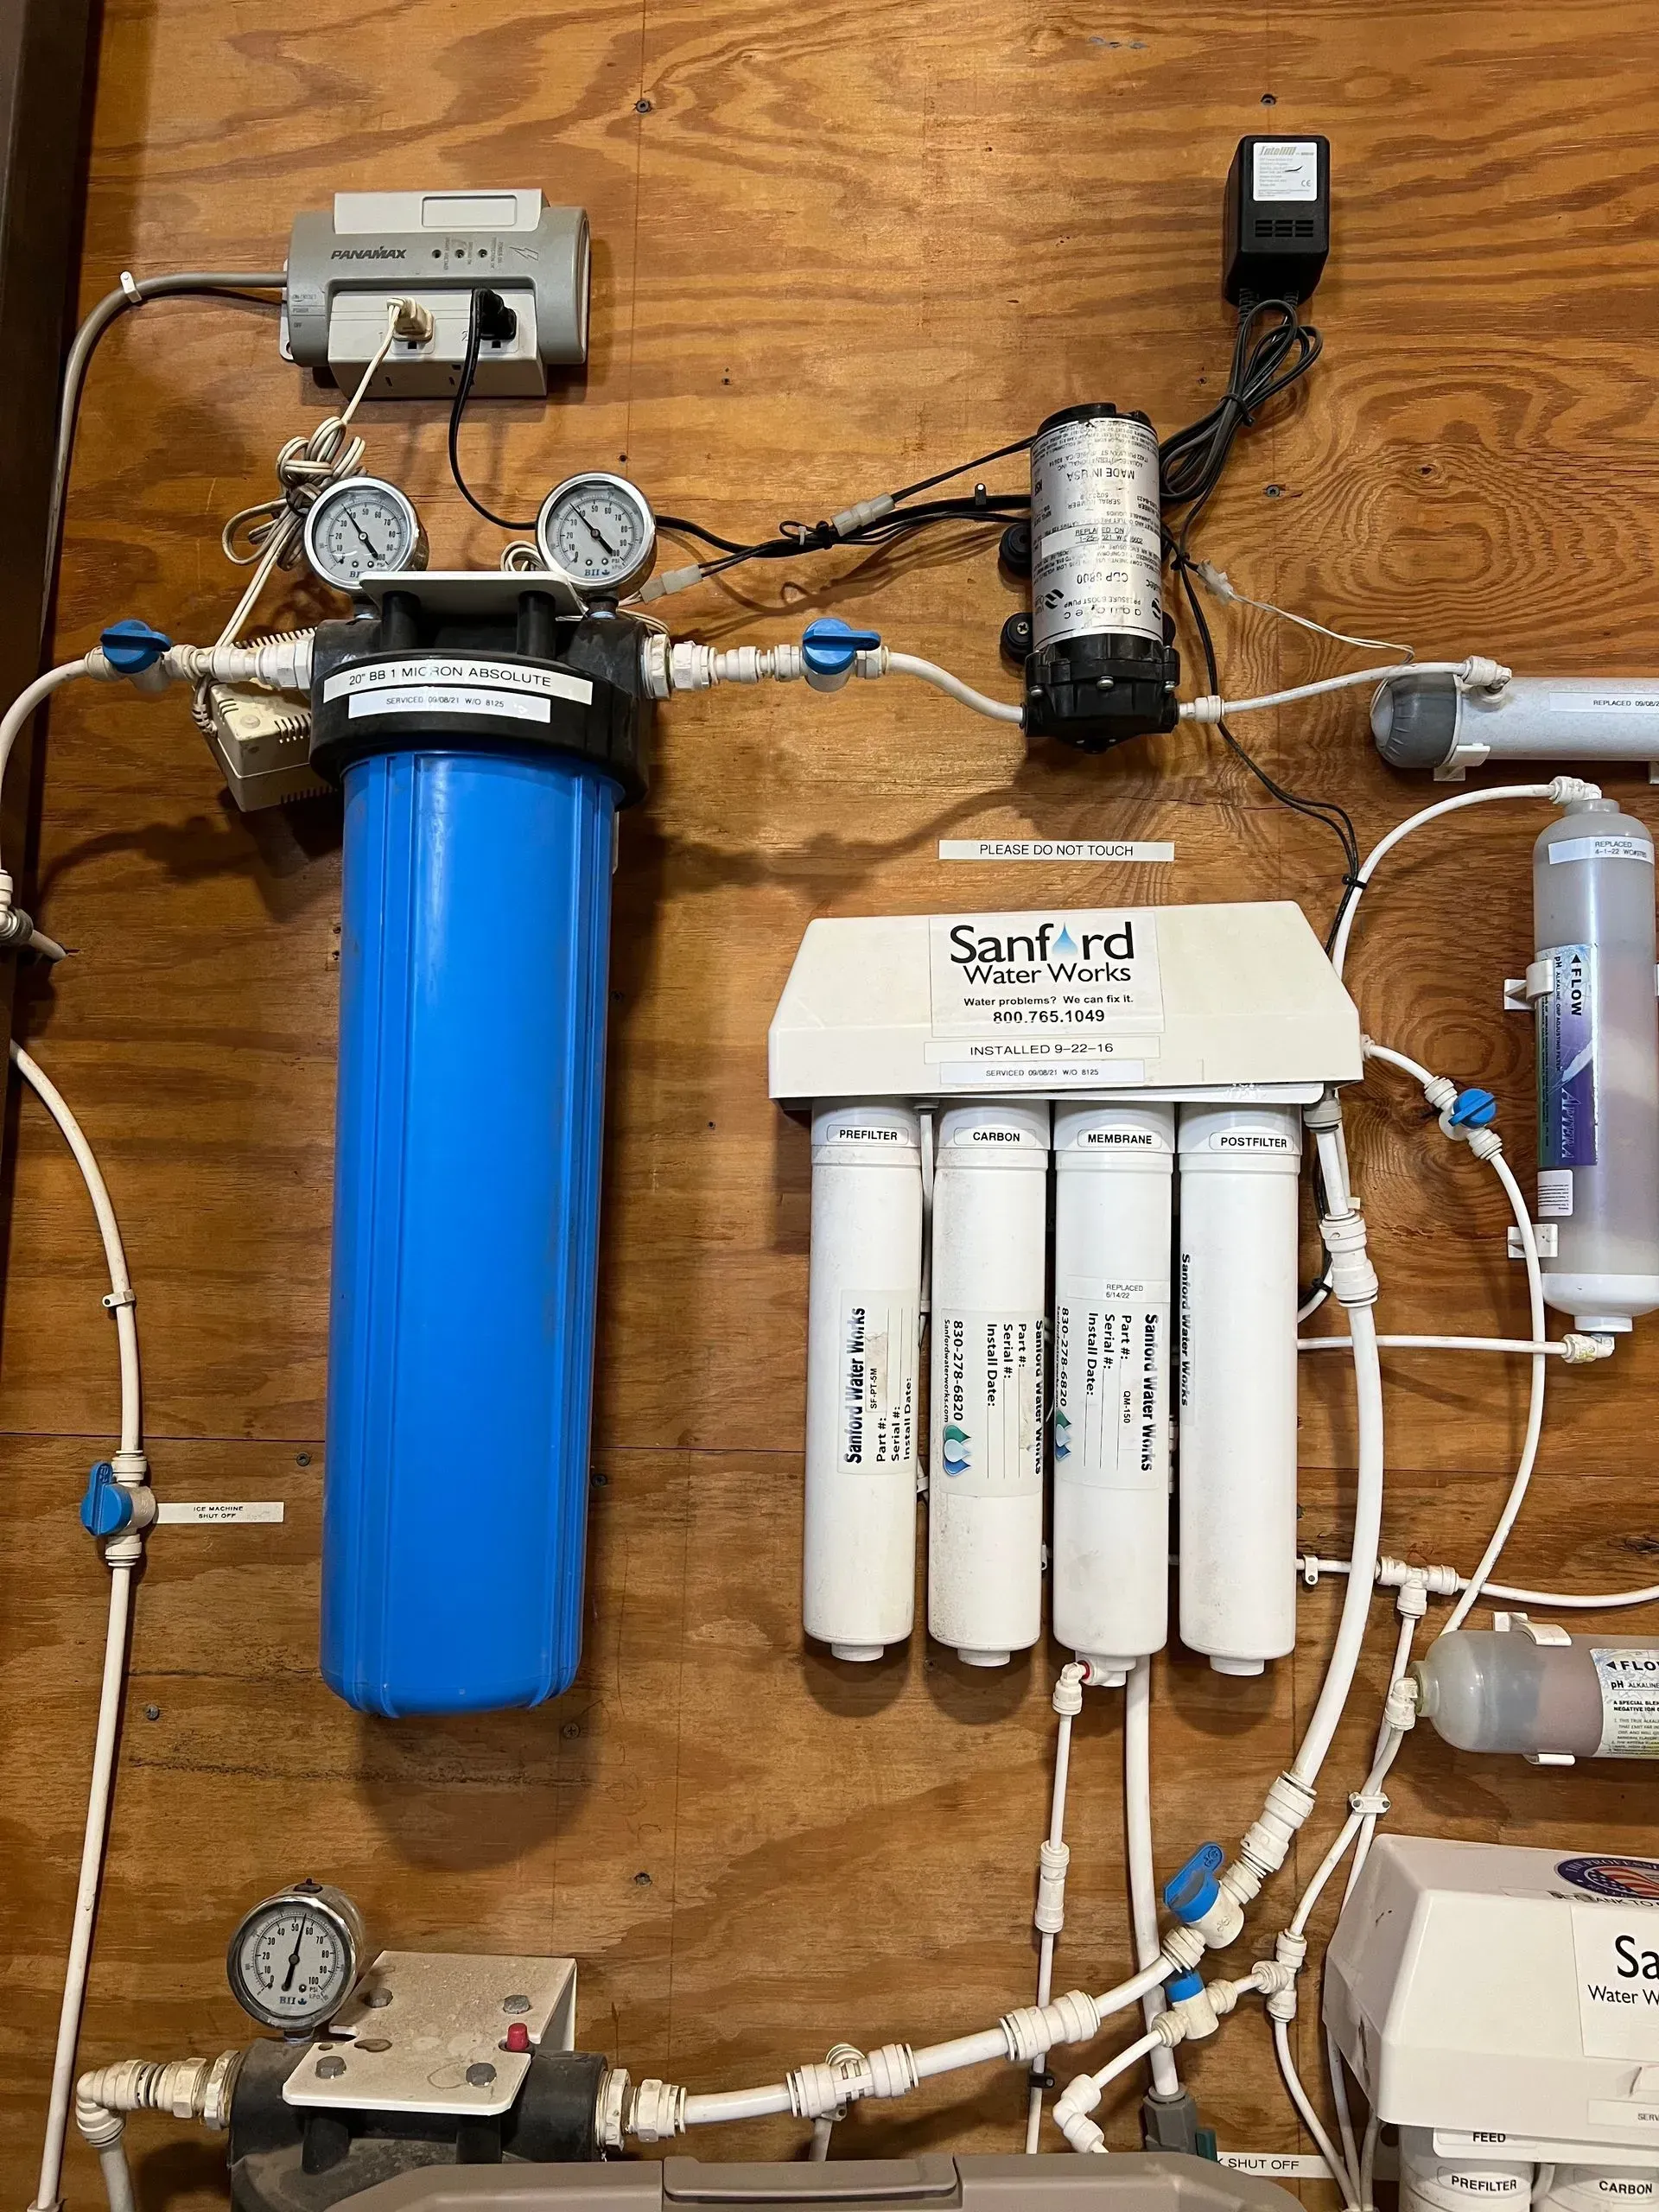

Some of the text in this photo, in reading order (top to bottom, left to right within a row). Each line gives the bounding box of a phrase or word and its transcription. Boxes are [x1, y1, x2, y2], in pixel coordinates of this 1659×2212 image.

[331, 245, 407, 259] PANAMAX
[1066, 469, 1088, 481] USA
[1106, 467, 1135, 480] MADE
[1075, 527, 1111, 537] REPLAED
[1064, 599, 1082, 608] PUMP
[349, 666, 551, 687] 20" BB 1 MICRON ABSOLUTE
[386, 696, 505, 709] SERVICED 09/08/21 W/O 8125
[980, 844, 1134, 856] PLEASE DO NOT TOUCH
[950, 921, 1134, 963] Sanford
[1554, 956, 1561, 969] pH
[963, 963, 1131, 985] Water Works
[1571, 968, 1582, 1016] FLOW
[963, 997, 995, 1007] Water
[999, 995, 1057, 1007] problems?
[1063, 995, 1080, 1004] We
[1106, 995, 1121, 1003] fix
[1123, 994, 1134, 1003] it.
[993, 1009, 1105, 1024] 800.765.1049
[970, 1043, 1114, 1056] INSTALLED 9-22-16
[1561, 1088, 1582, 1159] APTERA
[839, 1129, 898, 1141] PREFILTER
[973, 1132, 1020, 1142] CARBON
[1087, 1134, 1153, 1144] MEMBRANE
[1220, 1137, 1287, 1148] POSTFILTER
[1120, 1315, 1132, 1360] Part #:
[1180, 1253, 1191, 1407] Sanford Water Works
[1019, 1323, 1027, 1368] Part #:
[1103, 1313, 1116, 1370] Serial #:
[1003, 1324, 1014, 1379] Serial #:
[1060, 1307, 1069, 1407] 830-278-6820
[1086, 1313, 1098, 1396] Install Date:
[954, 1320, 963, 1421] 830-278-6820
[987, 1324, 998, 1407] Install Date:
[844, 1307, 866, 1465] Sanford Water Works
[1141, 1313, 1159, 1471] Sanford Water Works
[1035, 1320, 1044, 1475] Sanford Water Works
[876, 1417, 887, 1462] Part #:
[892, 1406, 900, 1461] Serial #:
[1620, 1661, 1659, 1671] FLO
[1611, 1681, 1624, 1690] pH
[277, 1928, 285, 1936] 40
[305, 1927, 314, 1936] 60
[1587, 1985, 1638, 2005] Water
[1472, 2132, 1506, 2143] FEED
[1228, 2158, 1267, 2169] SHUT
[1271, 2159, 1300, 2171] OFF
[1451, 2176, 1517, 2192] PREFILTER
[1599, 2180, 1653, 2195] CARBON
